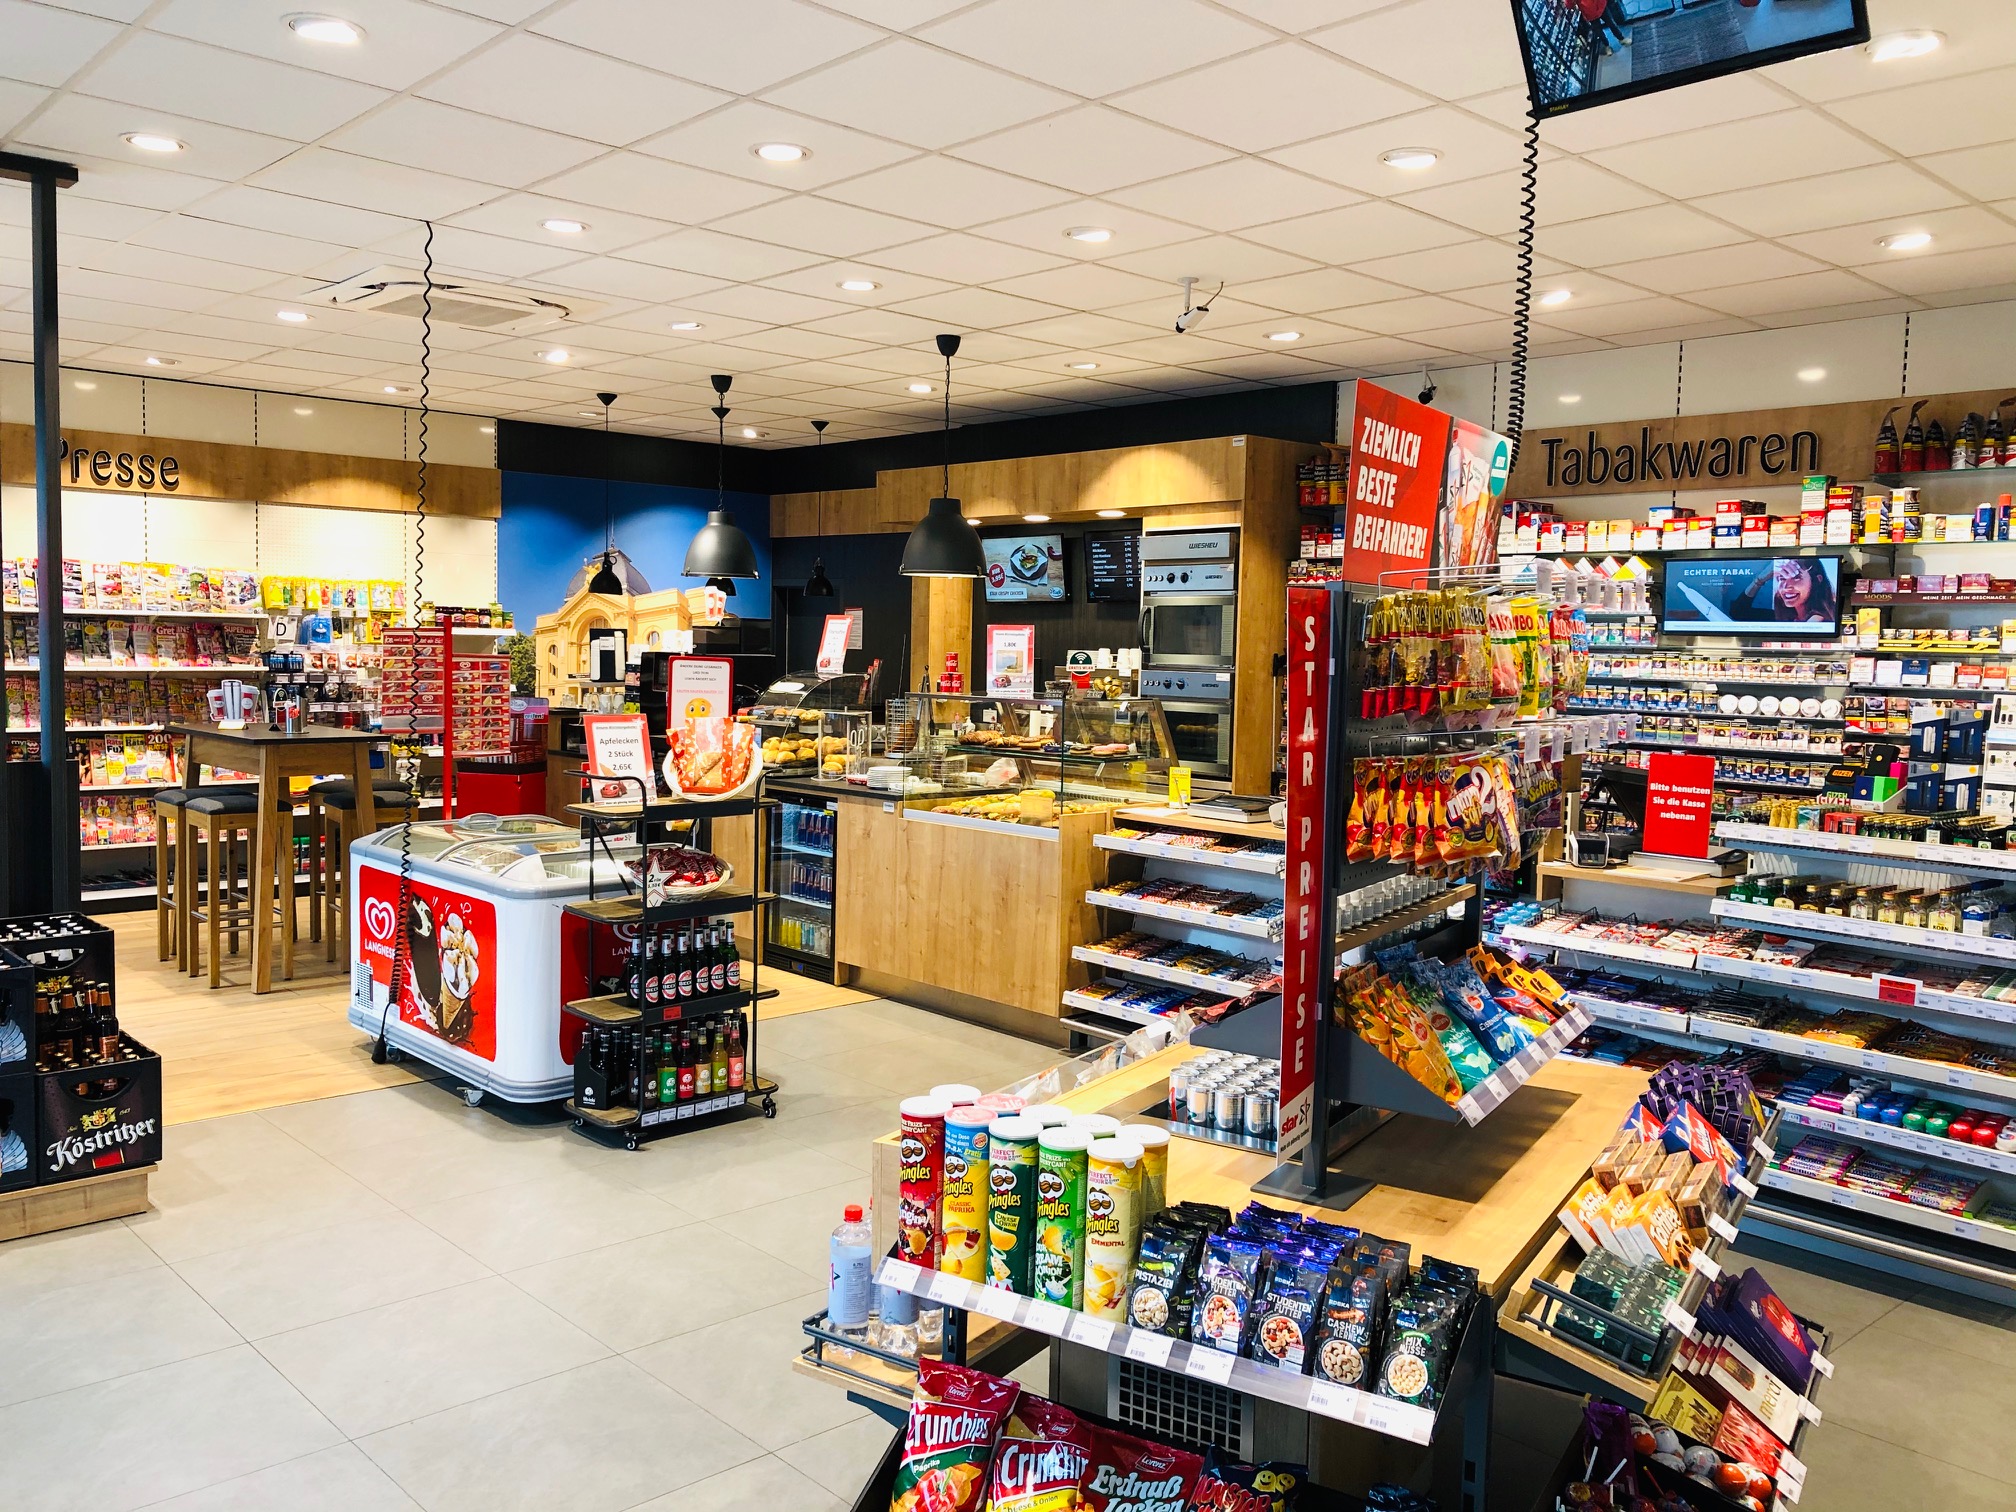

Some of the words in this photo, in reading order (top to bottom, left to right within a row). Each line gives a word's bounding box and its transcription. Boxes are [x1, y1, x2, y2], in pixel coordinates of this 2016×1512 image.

[1360, 416, 1422, 468] ZIEMLICH
[1541, 426, 1819, 487] Tabakwaren
[1357, 466, 1398, 508] BESTE
[1352, 514, 1429, 559] BEIFAHRER!
[1721, 568, 1754, 576] TABAK.
[224, 626, 244, 634] SUPER
[276, 622, 287, 636] D
[1302, 616, 1316, 787] STAR
[600, 737, 639, 745] Apfelecken
[1832, 769, 1855, 777] GIZEH
[1529, 779, 1558, 803] Softies
[1650, 782, 1670, 791] Bitte
[1672, 784, 1710, 794] benutzen
[1653, 796, 1665, 804] Sie
[1667, 798, 1680, 806] die
[1682, 799, 1706, 808] Kasse
[1660, 811, 1695, 821] nebenan
[649, 874, 655, 883] 2
[1294, 816, 1312, 1074] PREISE
[1281, 1114, 1298, 1137] star
[46, 1117, 156, 1171] Köstritzer
[988, 1191, 1021, 1210] Pringles
[948, 1205, 975, 1213] PAPRIKA
[1091, 1238, 1125, 1247] EMMENTAL
[1142, 1250, 1162, 1260] EDEKA
[1135, 1269, 1174, 1289] PISTAZIEN
[1203, 1273, 1246, 1292] STUDENTEN
[1274, 1276, 1295, 1287] EDEKA
[1211, 1283, 1237, 1298] FUTTER
[1267, 1293, 1312, 1313] STUDENTEN
[1329, 1299, 1349, 1309] EDEKA
[1273, 1303, 1302, 1320] FUTTER
[1327, 1318, 1365, 1336] CASHEW
[1396, 1319, 1418, 1329] EDEKA
[1333, 1329, 1358, 1343] KERNE
[1405, 1336, 1423, 1348] MIX
[948, 1386, 967, 1398] Lorenz
[1758, 1374, 1783, 1420] merci
[905, 1410, 990, 1450] Crunchips
[913, 1459, 940, 1474] Paprika
[1142, 1456, 1168, 1469] Lorenz
[1088, 1465, 1184, 1499] Erdnuß
[1039, 1495, 1058, 1506] Onion
